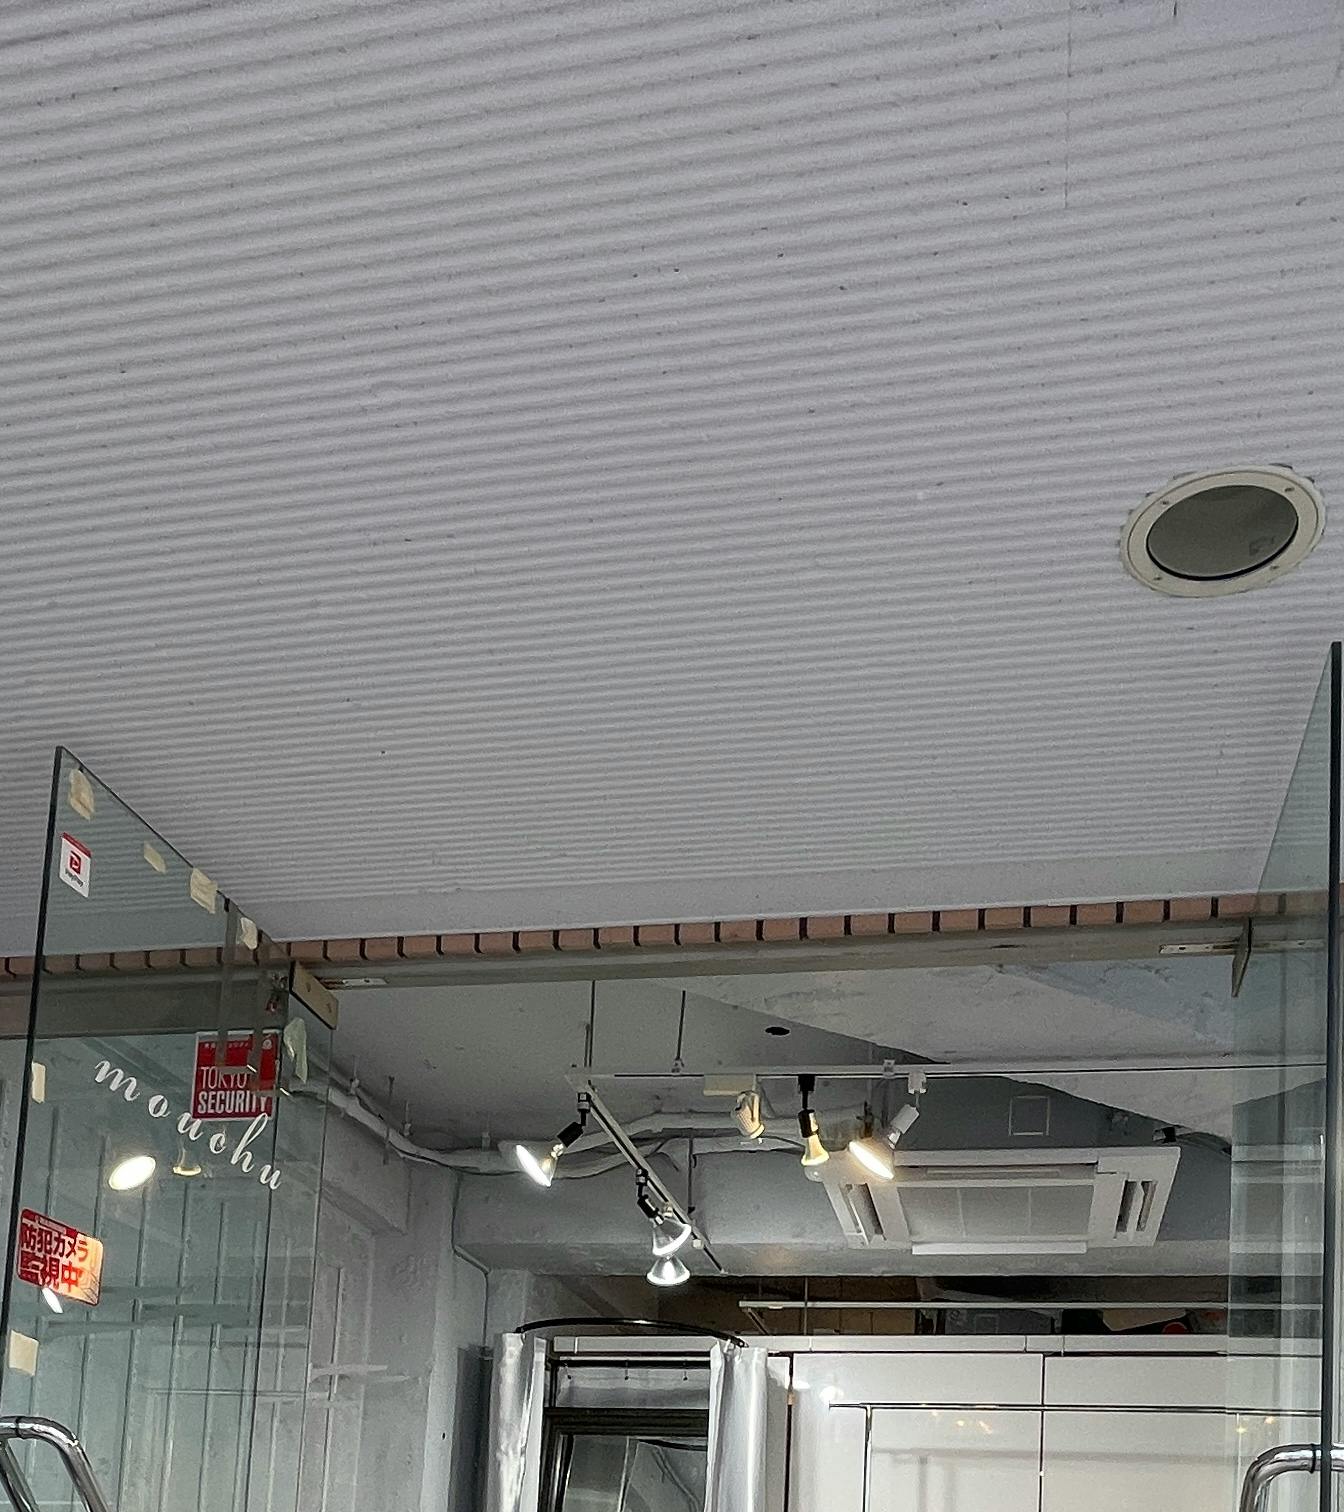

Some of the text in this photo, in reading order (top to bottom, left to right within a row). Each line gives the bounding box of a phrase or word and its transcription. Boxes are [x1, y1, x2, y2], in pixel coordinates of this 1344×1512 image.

[199, 1066, 248, 1089] TOKYO
[197, 1090, 267, 1114] SECURITY
[20, 1223, 89, 1263] 防犯カメラ
